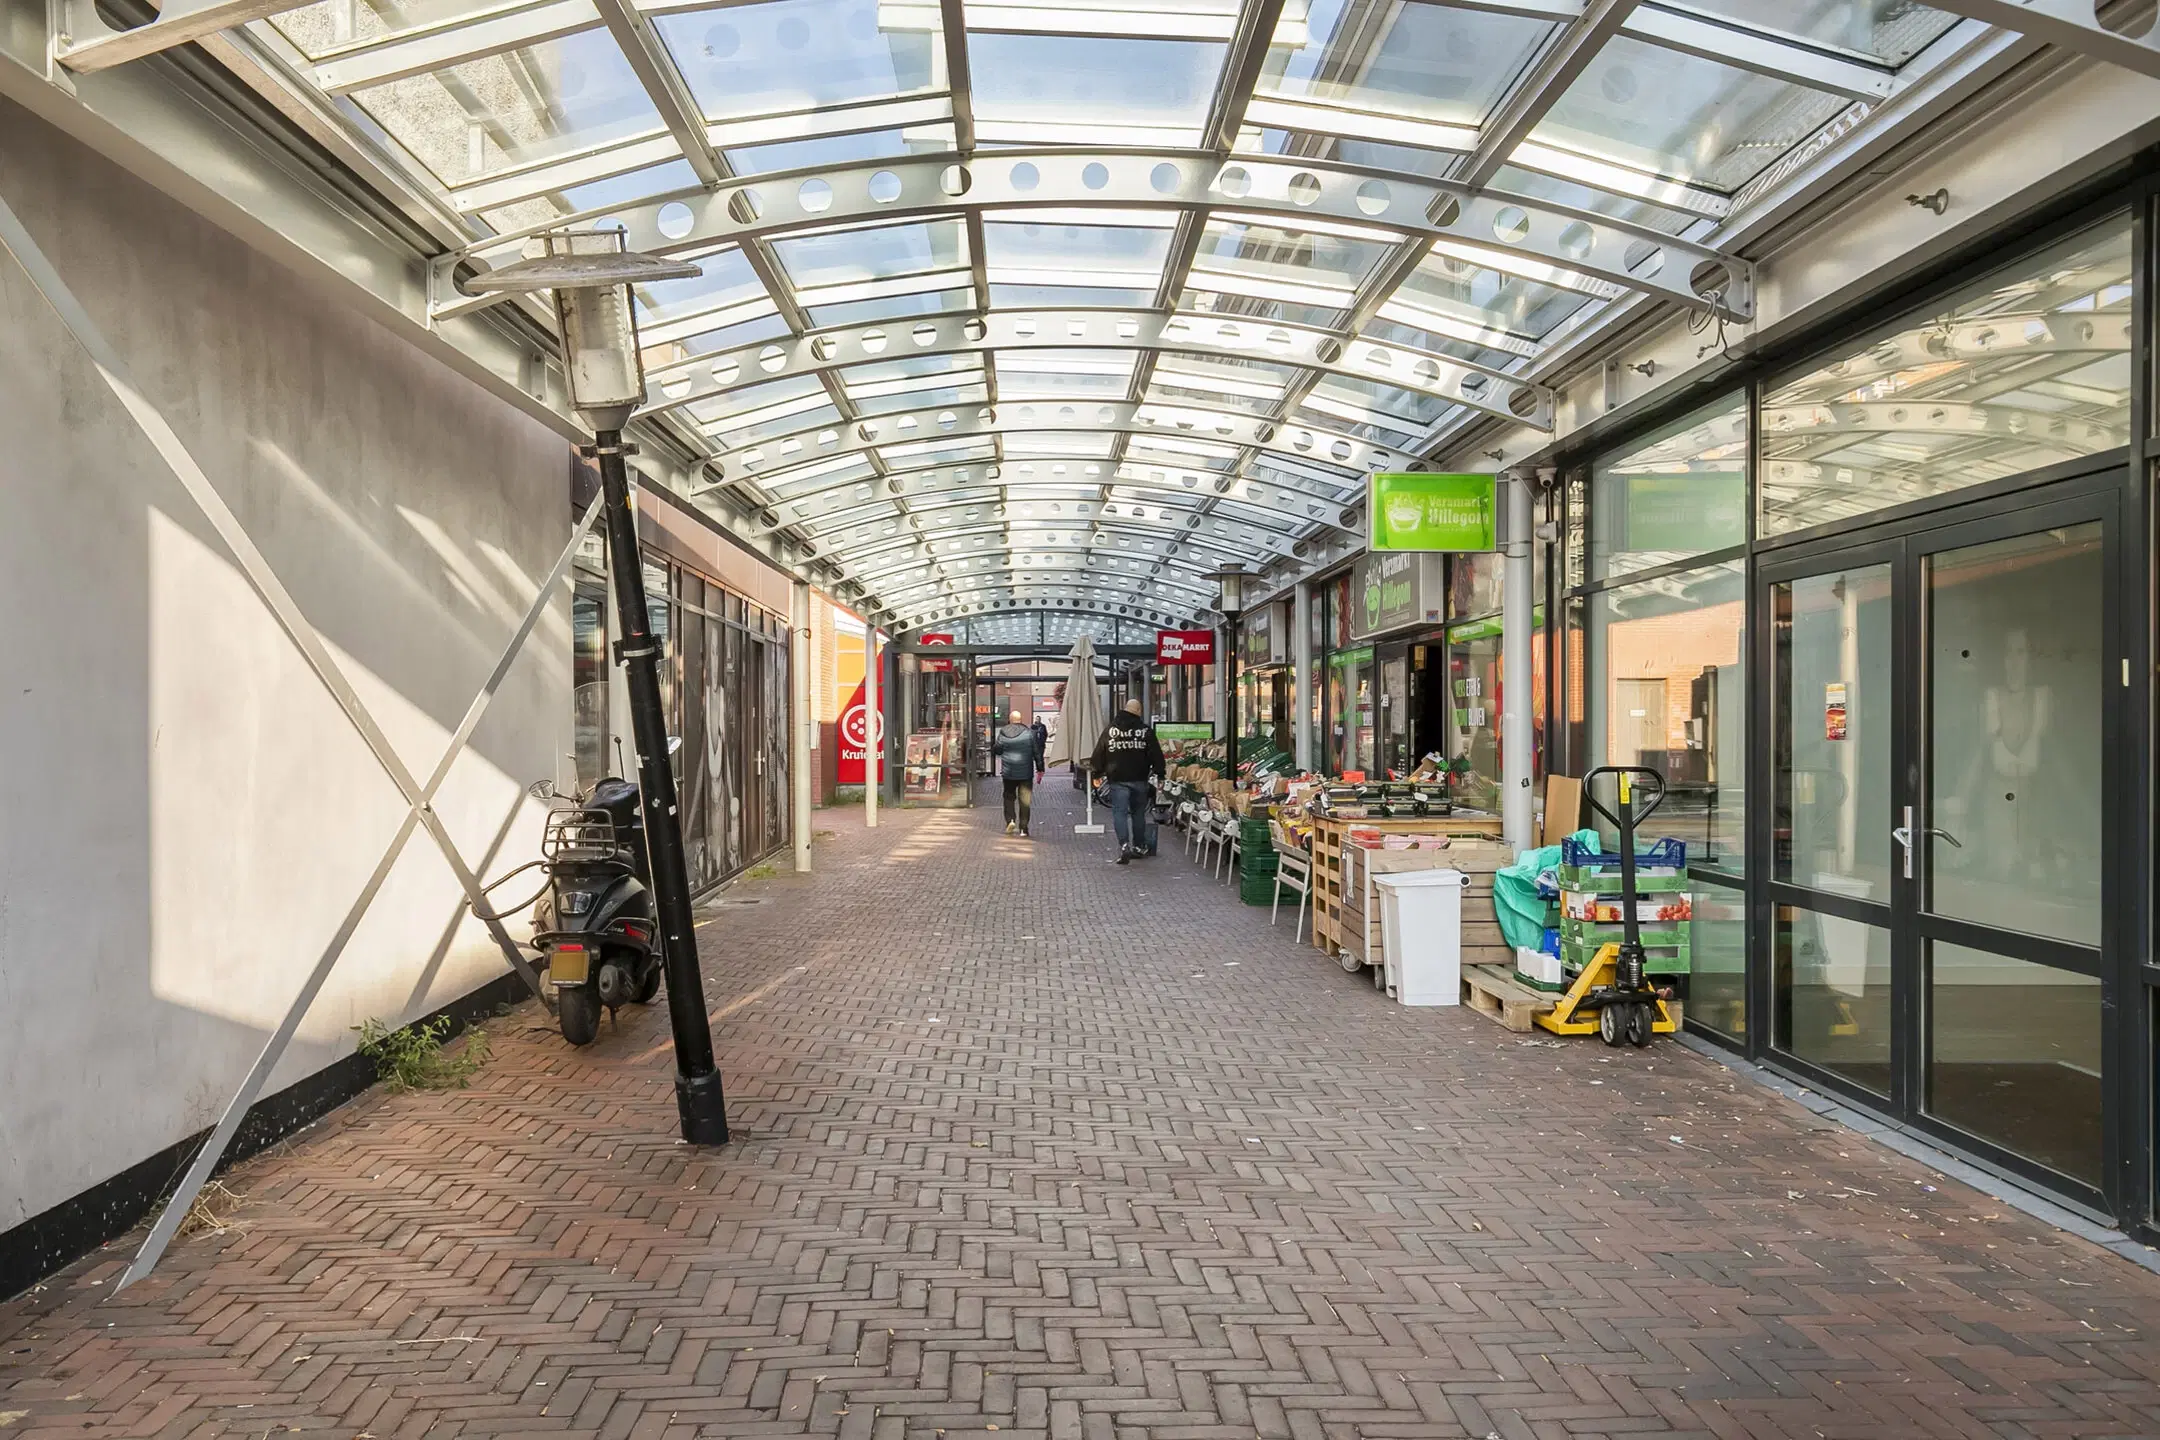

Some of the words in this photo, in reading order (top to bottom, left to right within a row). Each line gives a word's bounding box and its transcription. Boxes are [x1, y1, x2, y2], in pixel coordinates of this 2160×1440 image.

[1108, 726, 1133, 738] Out
[1134, 727, 1149, 738] of
[1108, 738, 1147, 753] Service
